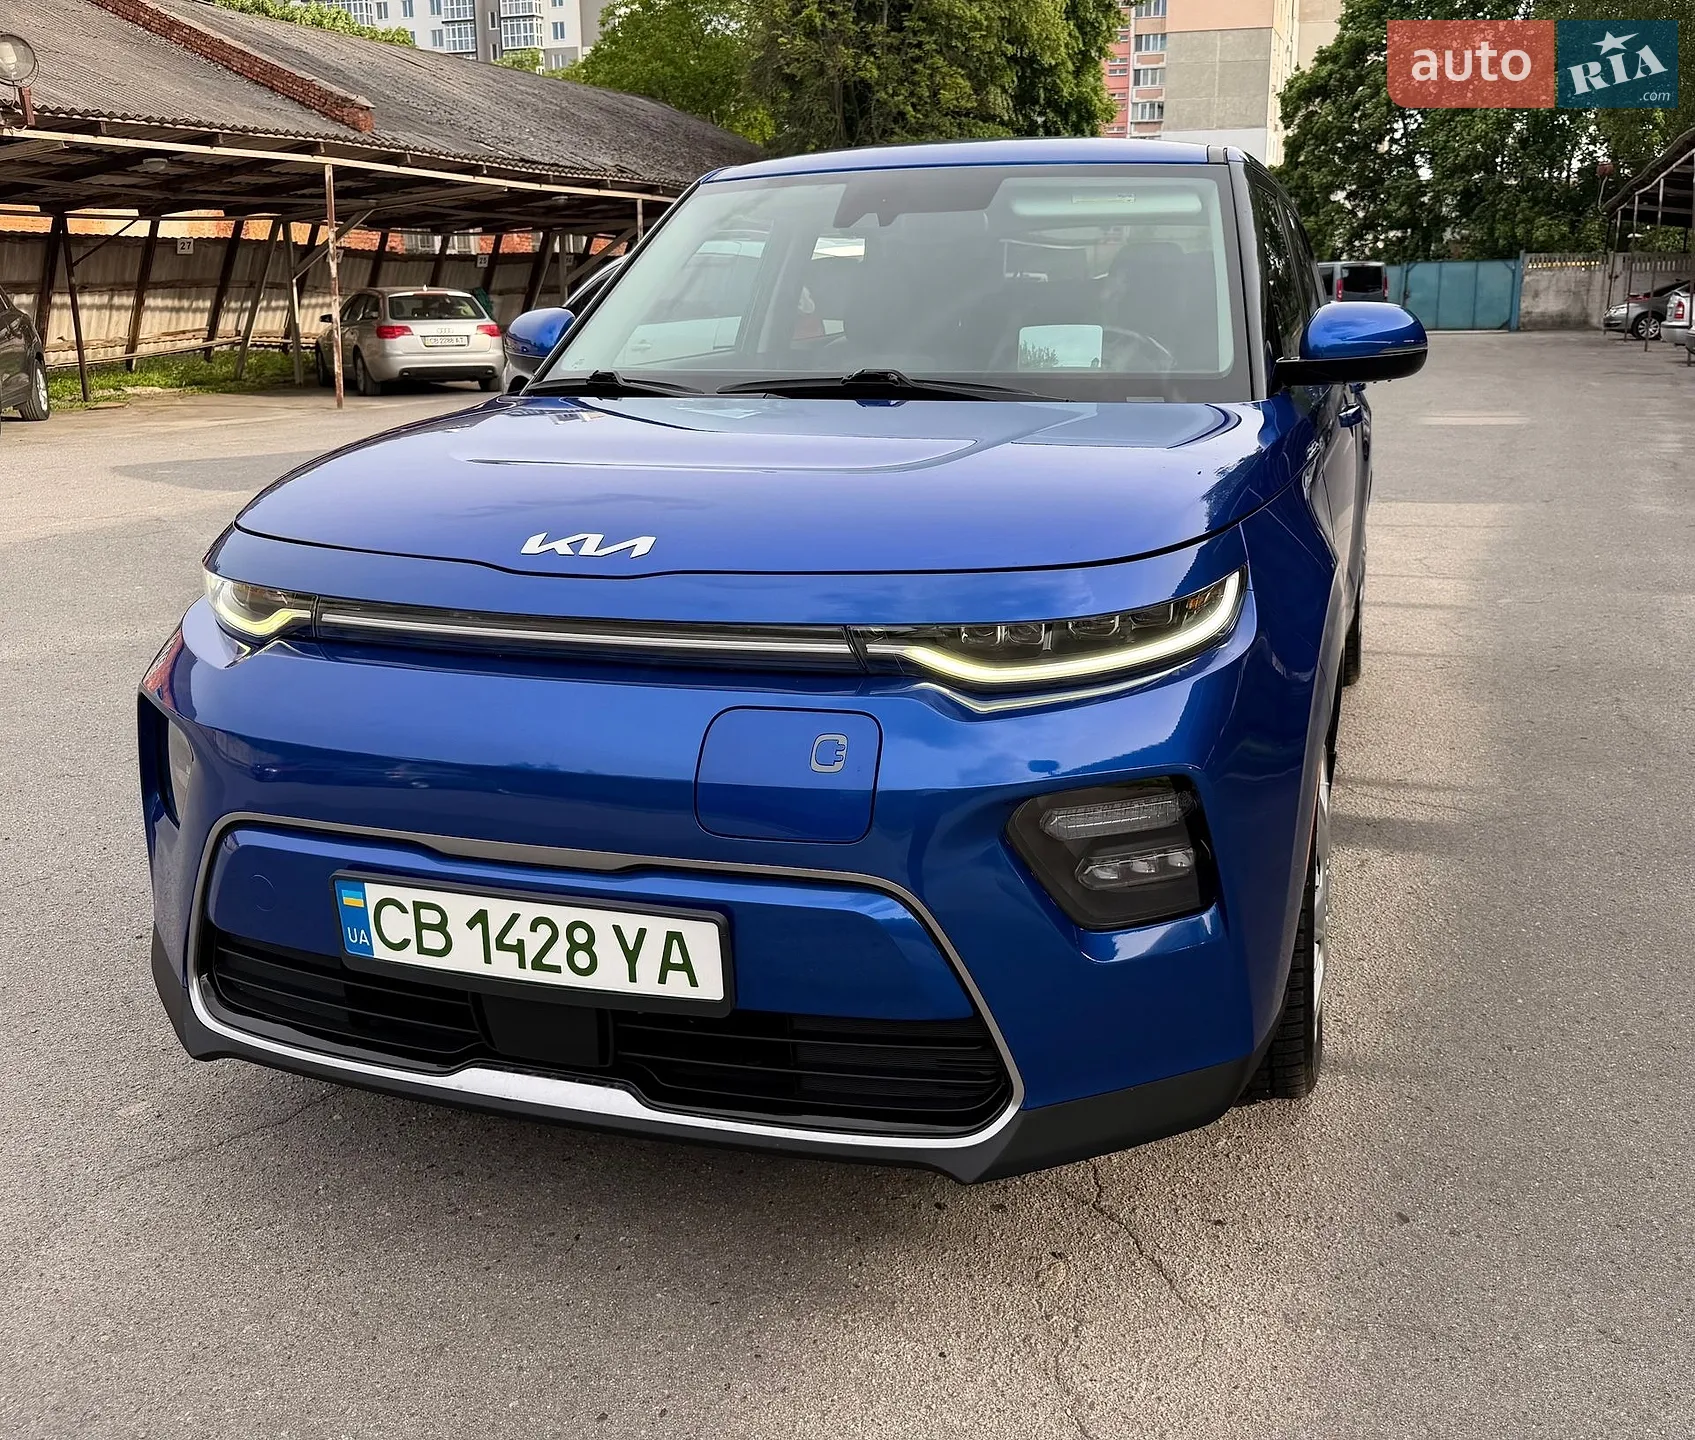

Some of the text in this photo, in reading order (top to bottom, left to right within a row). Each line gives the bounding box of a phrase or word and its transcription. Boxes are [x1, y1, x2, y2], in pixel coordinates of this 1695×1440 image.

[180, 241, 192, 250] 27
[520, 532, 657, 559] KIA
[347, 926, 370, 946] UA
[372, 897, 700, 988] CB 1428 YA
